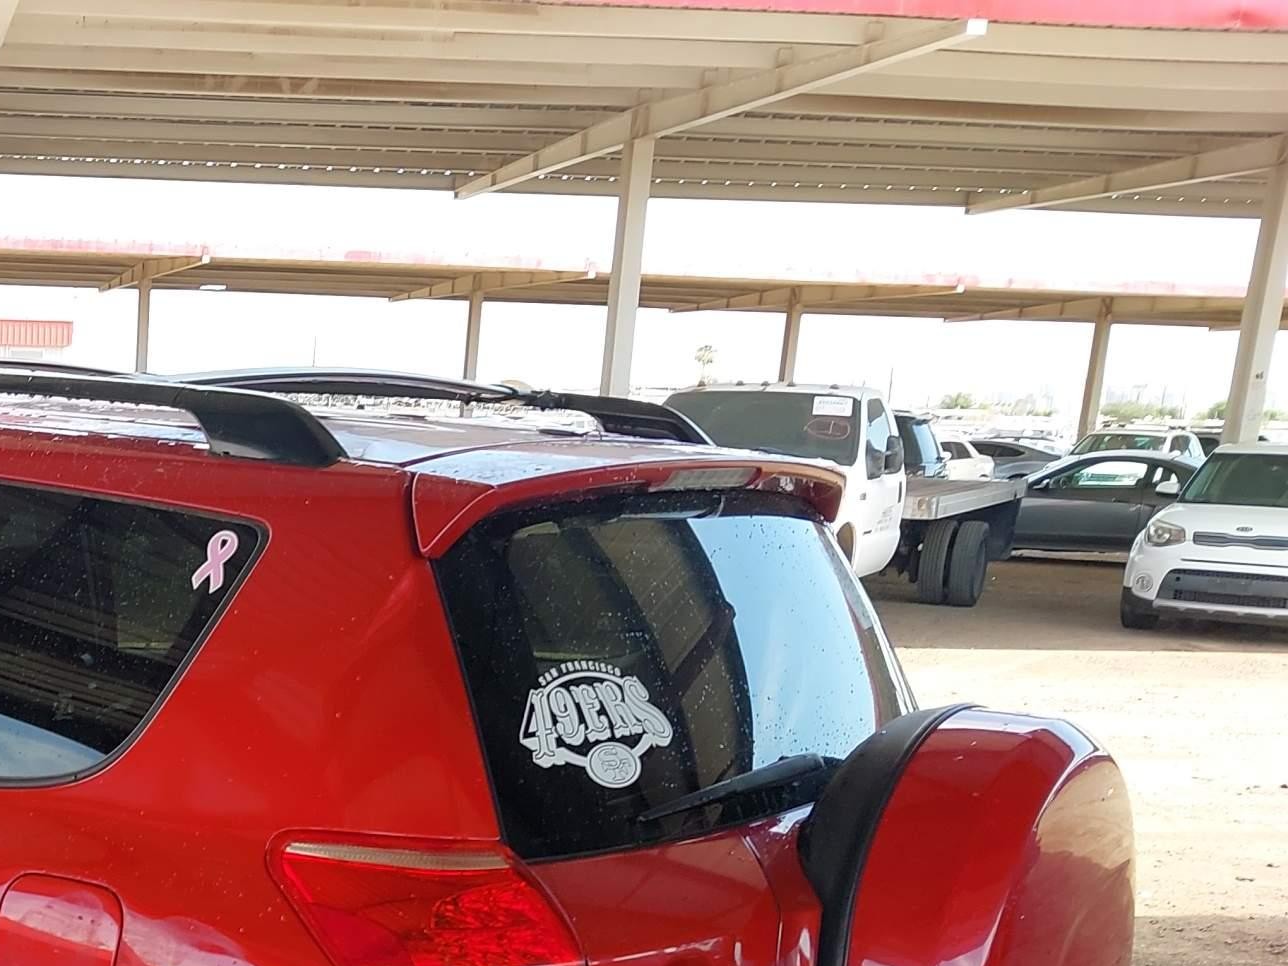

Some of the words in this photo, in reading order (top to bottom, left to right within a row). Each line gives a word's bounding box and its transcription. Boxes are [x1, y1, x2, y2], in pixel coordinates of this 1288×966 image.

[538, 667, 559, 687] SAN
[560, 660, 622, 677] FRANCISCO
[519, 675, 673, 768] 49ERS
